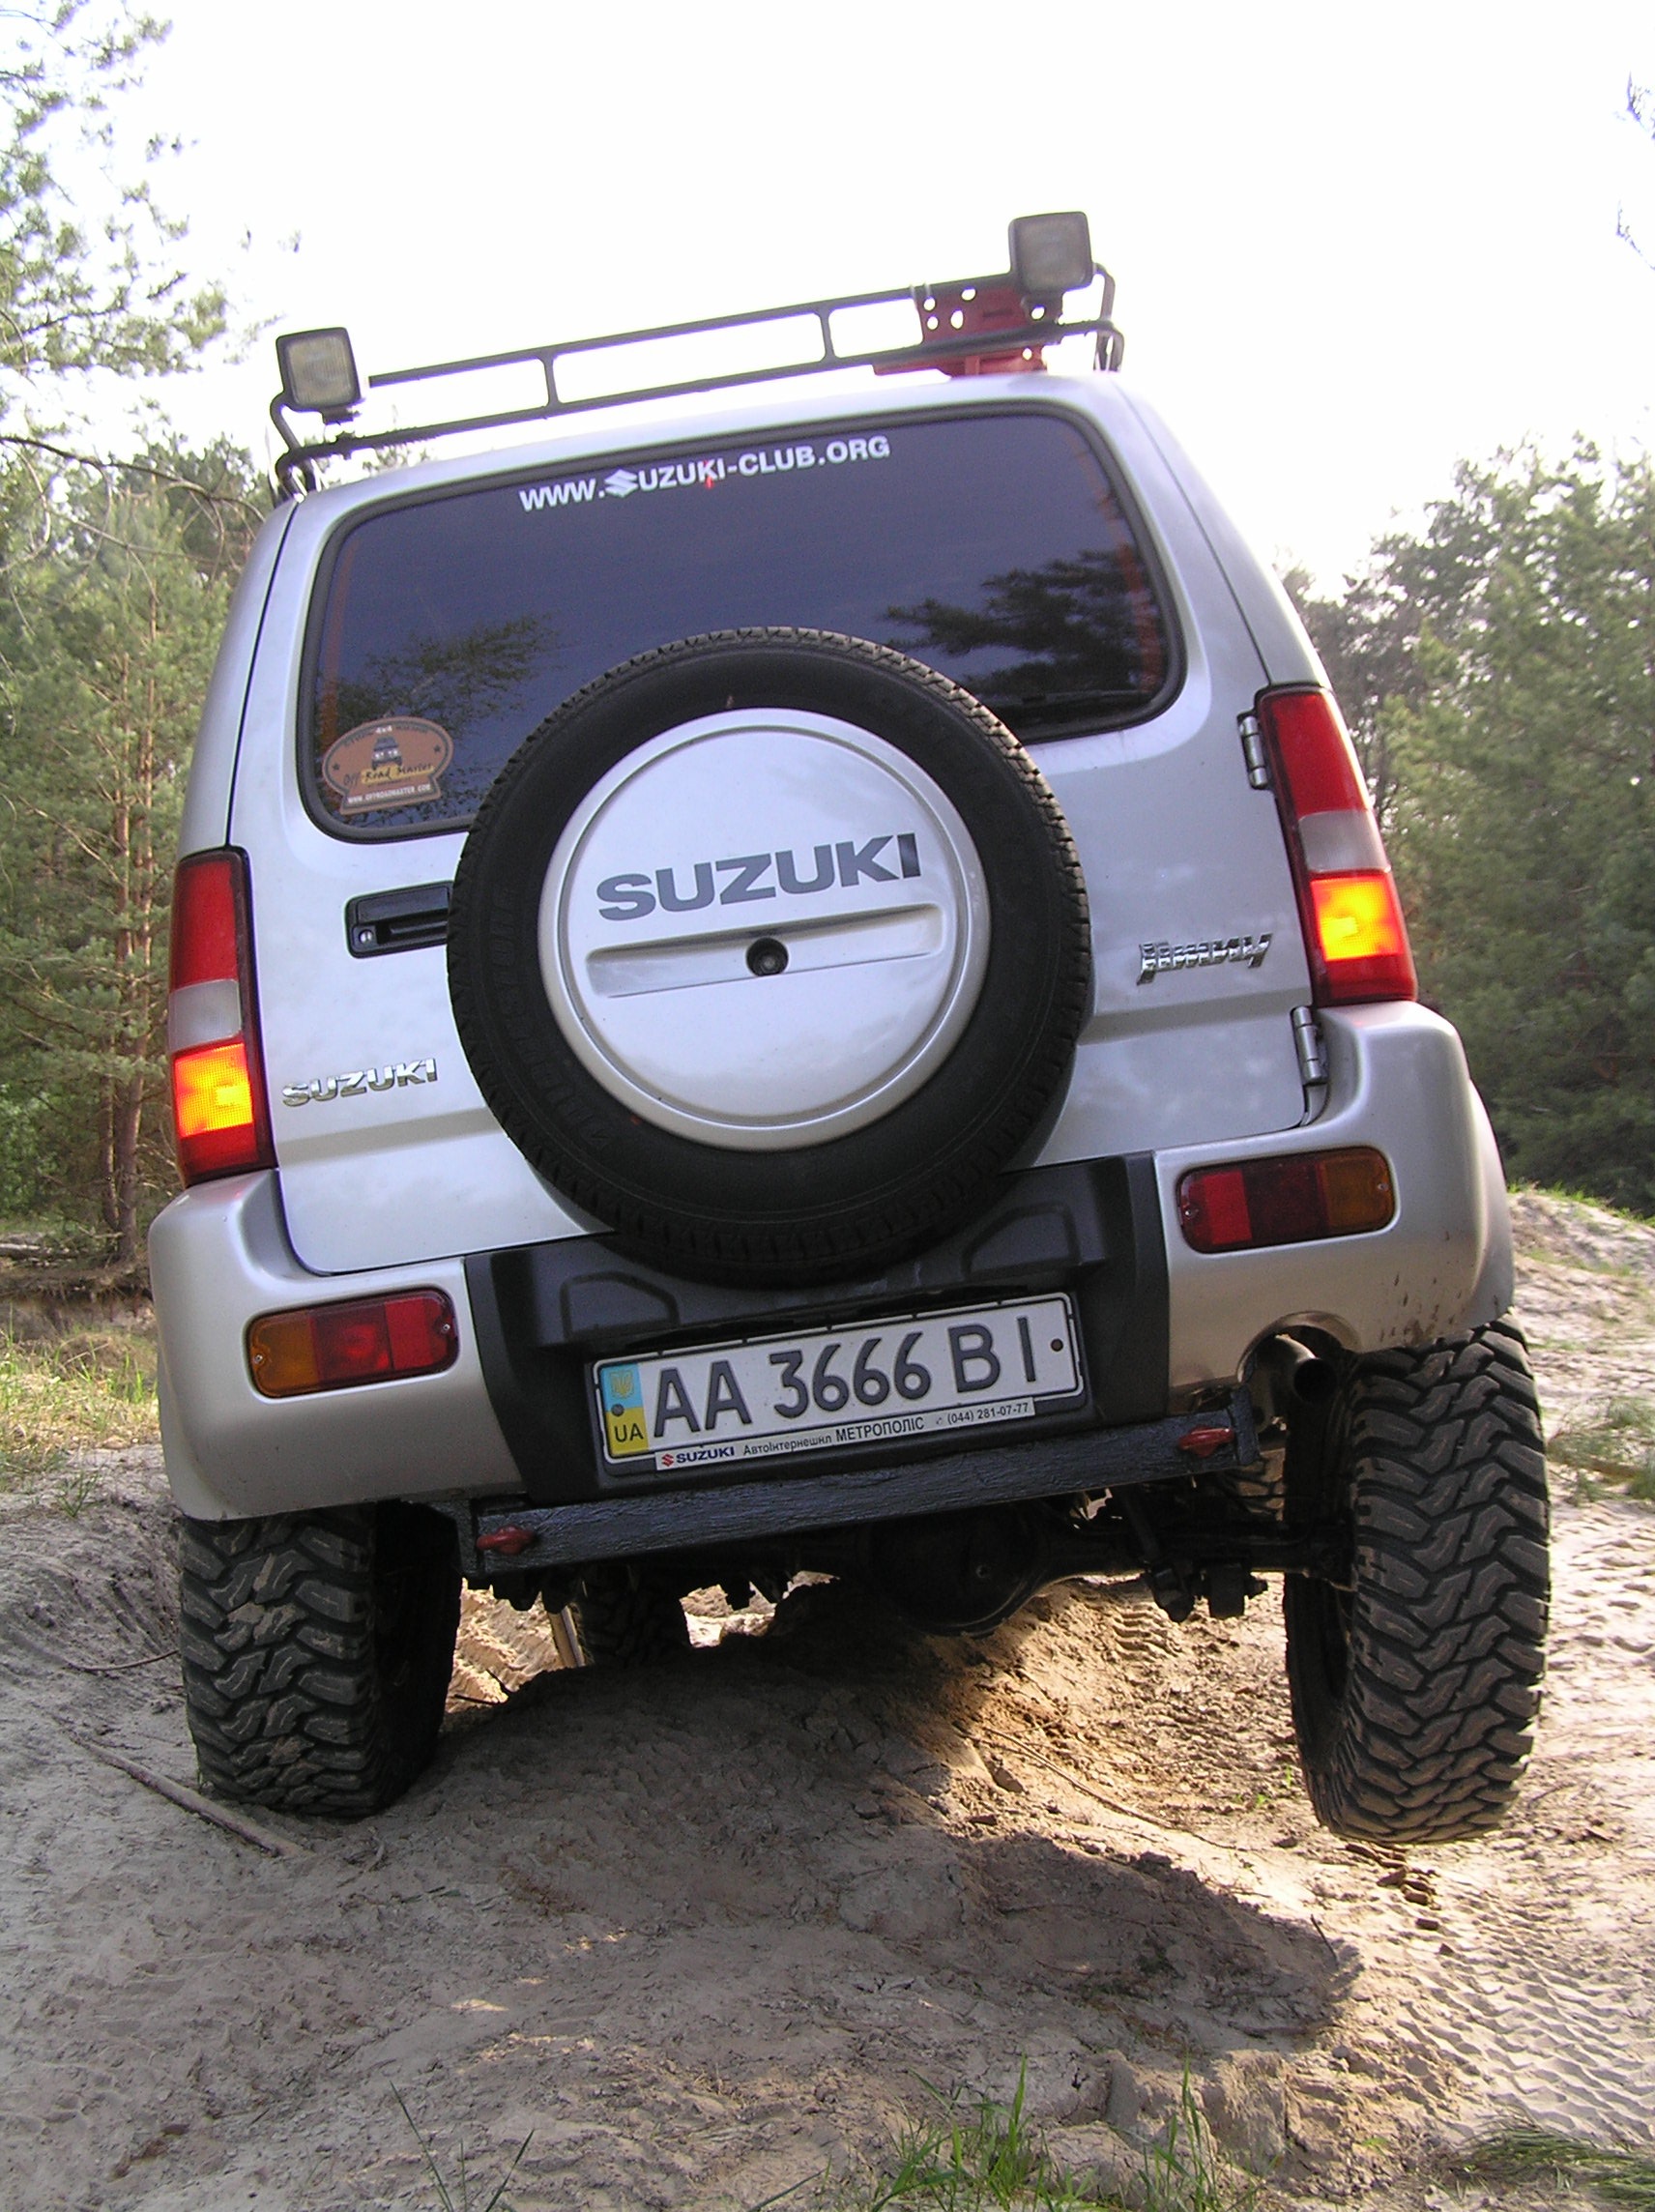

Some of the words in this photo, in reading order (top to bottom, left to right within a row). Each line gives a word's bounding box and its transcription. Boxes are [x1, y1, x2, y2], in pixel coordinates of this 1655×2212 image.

[596, 832, 921, 921] SUZUKI
[282, 1058, 438, 1107] SUZUKI
[653, 1359, 753, 1438] AA
[769, 1331, 931, 1418] 3666
[947, 1317, 1036, 1393] BI
[946, 1411, 974, 1426] (044)
[977, 1402, 1030, 1420] 281-07-77
[614, 1423, 644, 1442] UA
[835, 1416, 925, 1442] МЕТРОПОЛІС
[676, 1446, 735, 1465] SUZUKI
